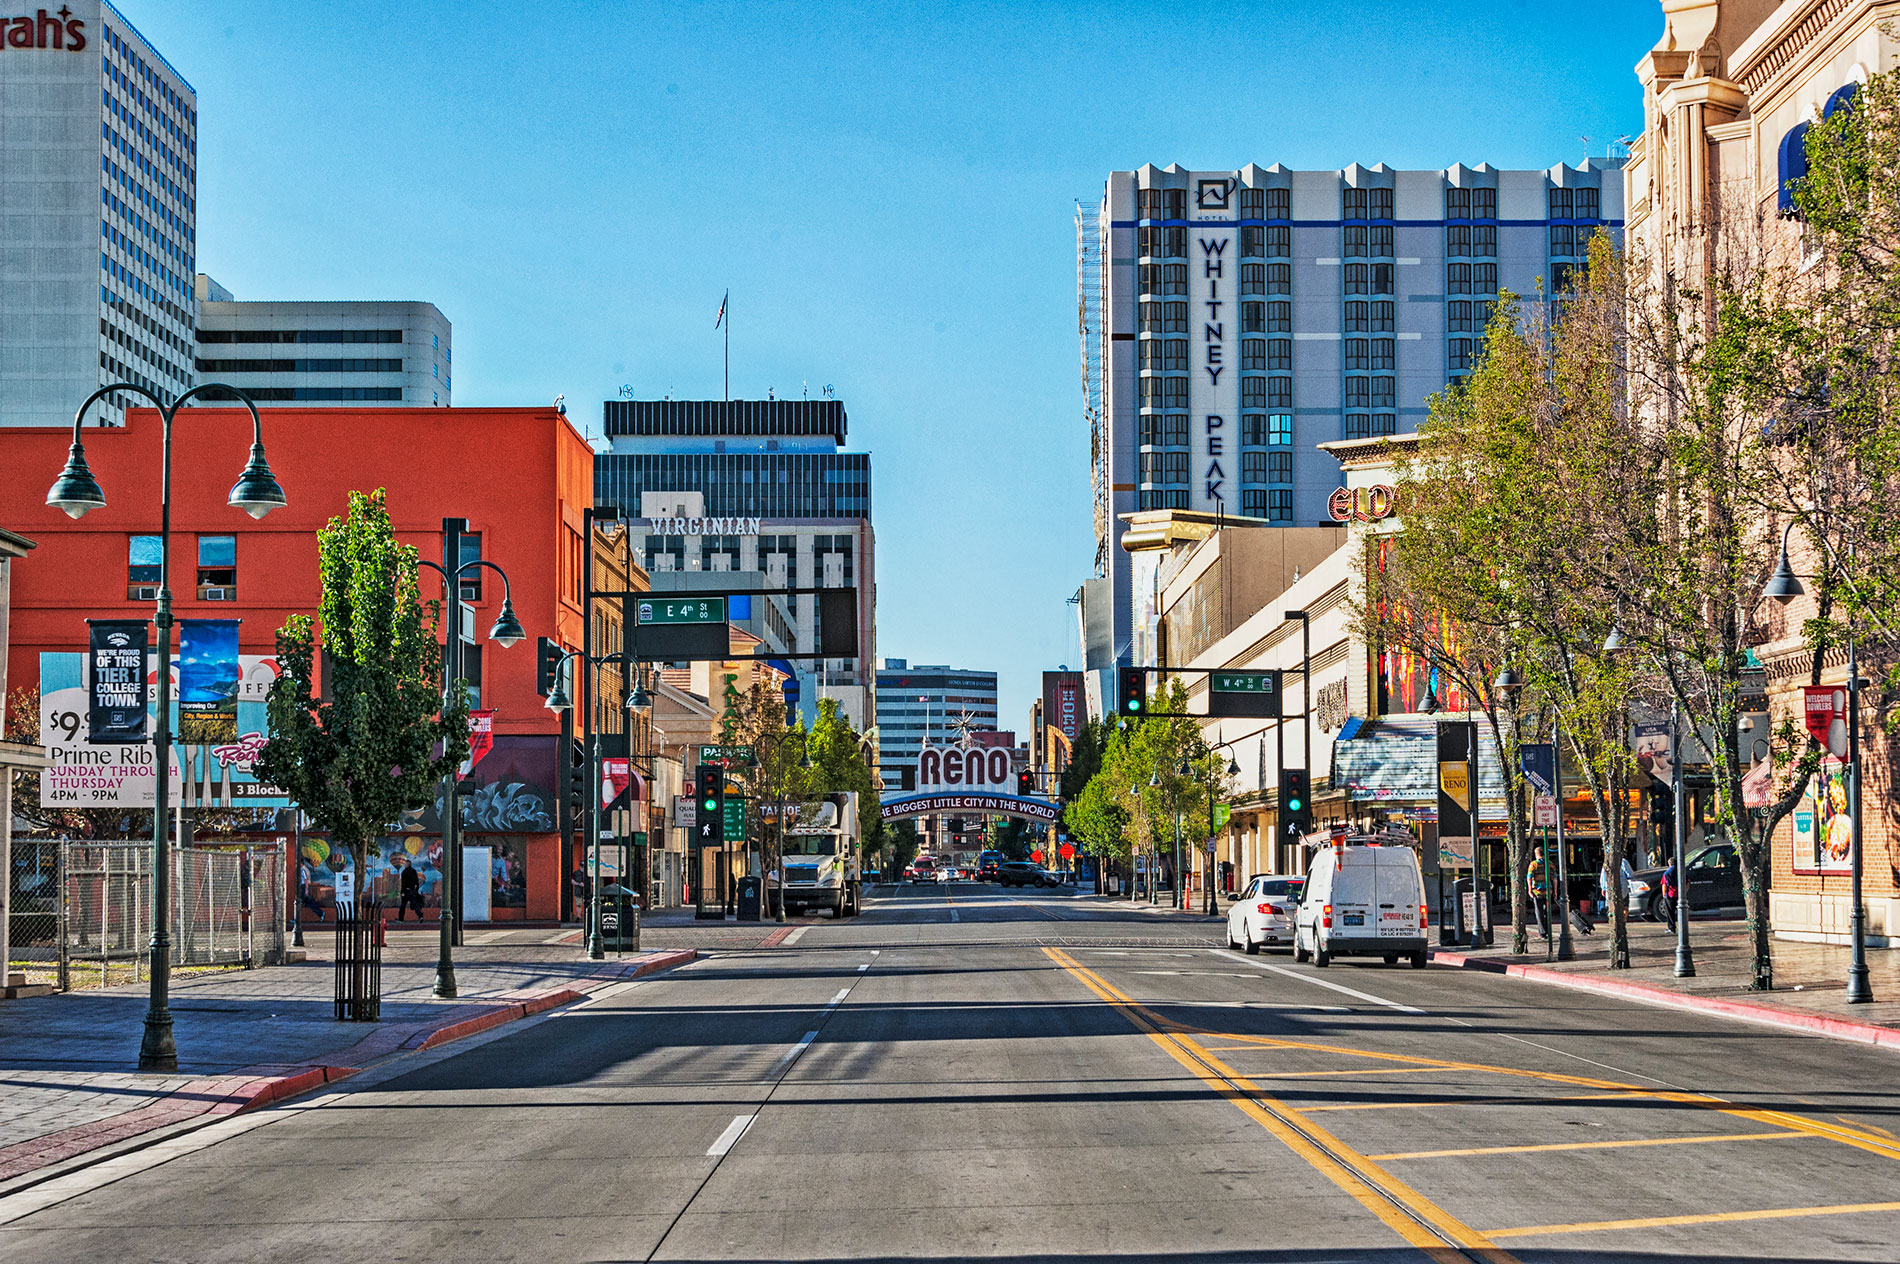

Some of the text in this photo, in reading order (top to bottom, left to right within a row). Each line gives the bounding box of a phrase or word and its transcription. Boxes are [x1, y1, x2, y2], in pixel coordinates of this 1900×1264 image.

[1199, 238, 1229, 501] WHITNEY PEAK
[650, 517, 761, 535] VIRGINIAN
[667, 605, 674, 617] E
[680, 605, 694, 617] 4th
[700, 603, 707, 611] St
[96, 656, 140, 667] OF THIS
[96, 668, 140, 682] TIER 1
[1223, 678, 1230, 687] W
[1234, 678, 1244, 687] 4th
[96, 683, 141, 693] COLLEGE
[97, 694, 140, 707] TOWN.
[180, 702, 205, 710] Improving
[1806, 703, 1833, 711] BOWLERS
[51, 745, 152, 764] Prime Rib
[50, 766, 178, 776] SUNDAY THROUH
[921, 750, 1007, 784] RENO
[50, 778, 124, 788] THURSDAY
[1444, 780, 1466, 788] RENO
[50, 790, 78, 800] 4PM
[92, 790, 118, 800] 9PM
[237, 785, 244, 795] 3
[893, 800, 931, 815] BIGGEST
[934, 798, 960, 808] LITTLE
[964, 798, 984, 807] CITY
[985, 798, 996, 807] IN
[1000, 799, 1017, 810] THE
[1020, 802, 1055, 818] WORLD
